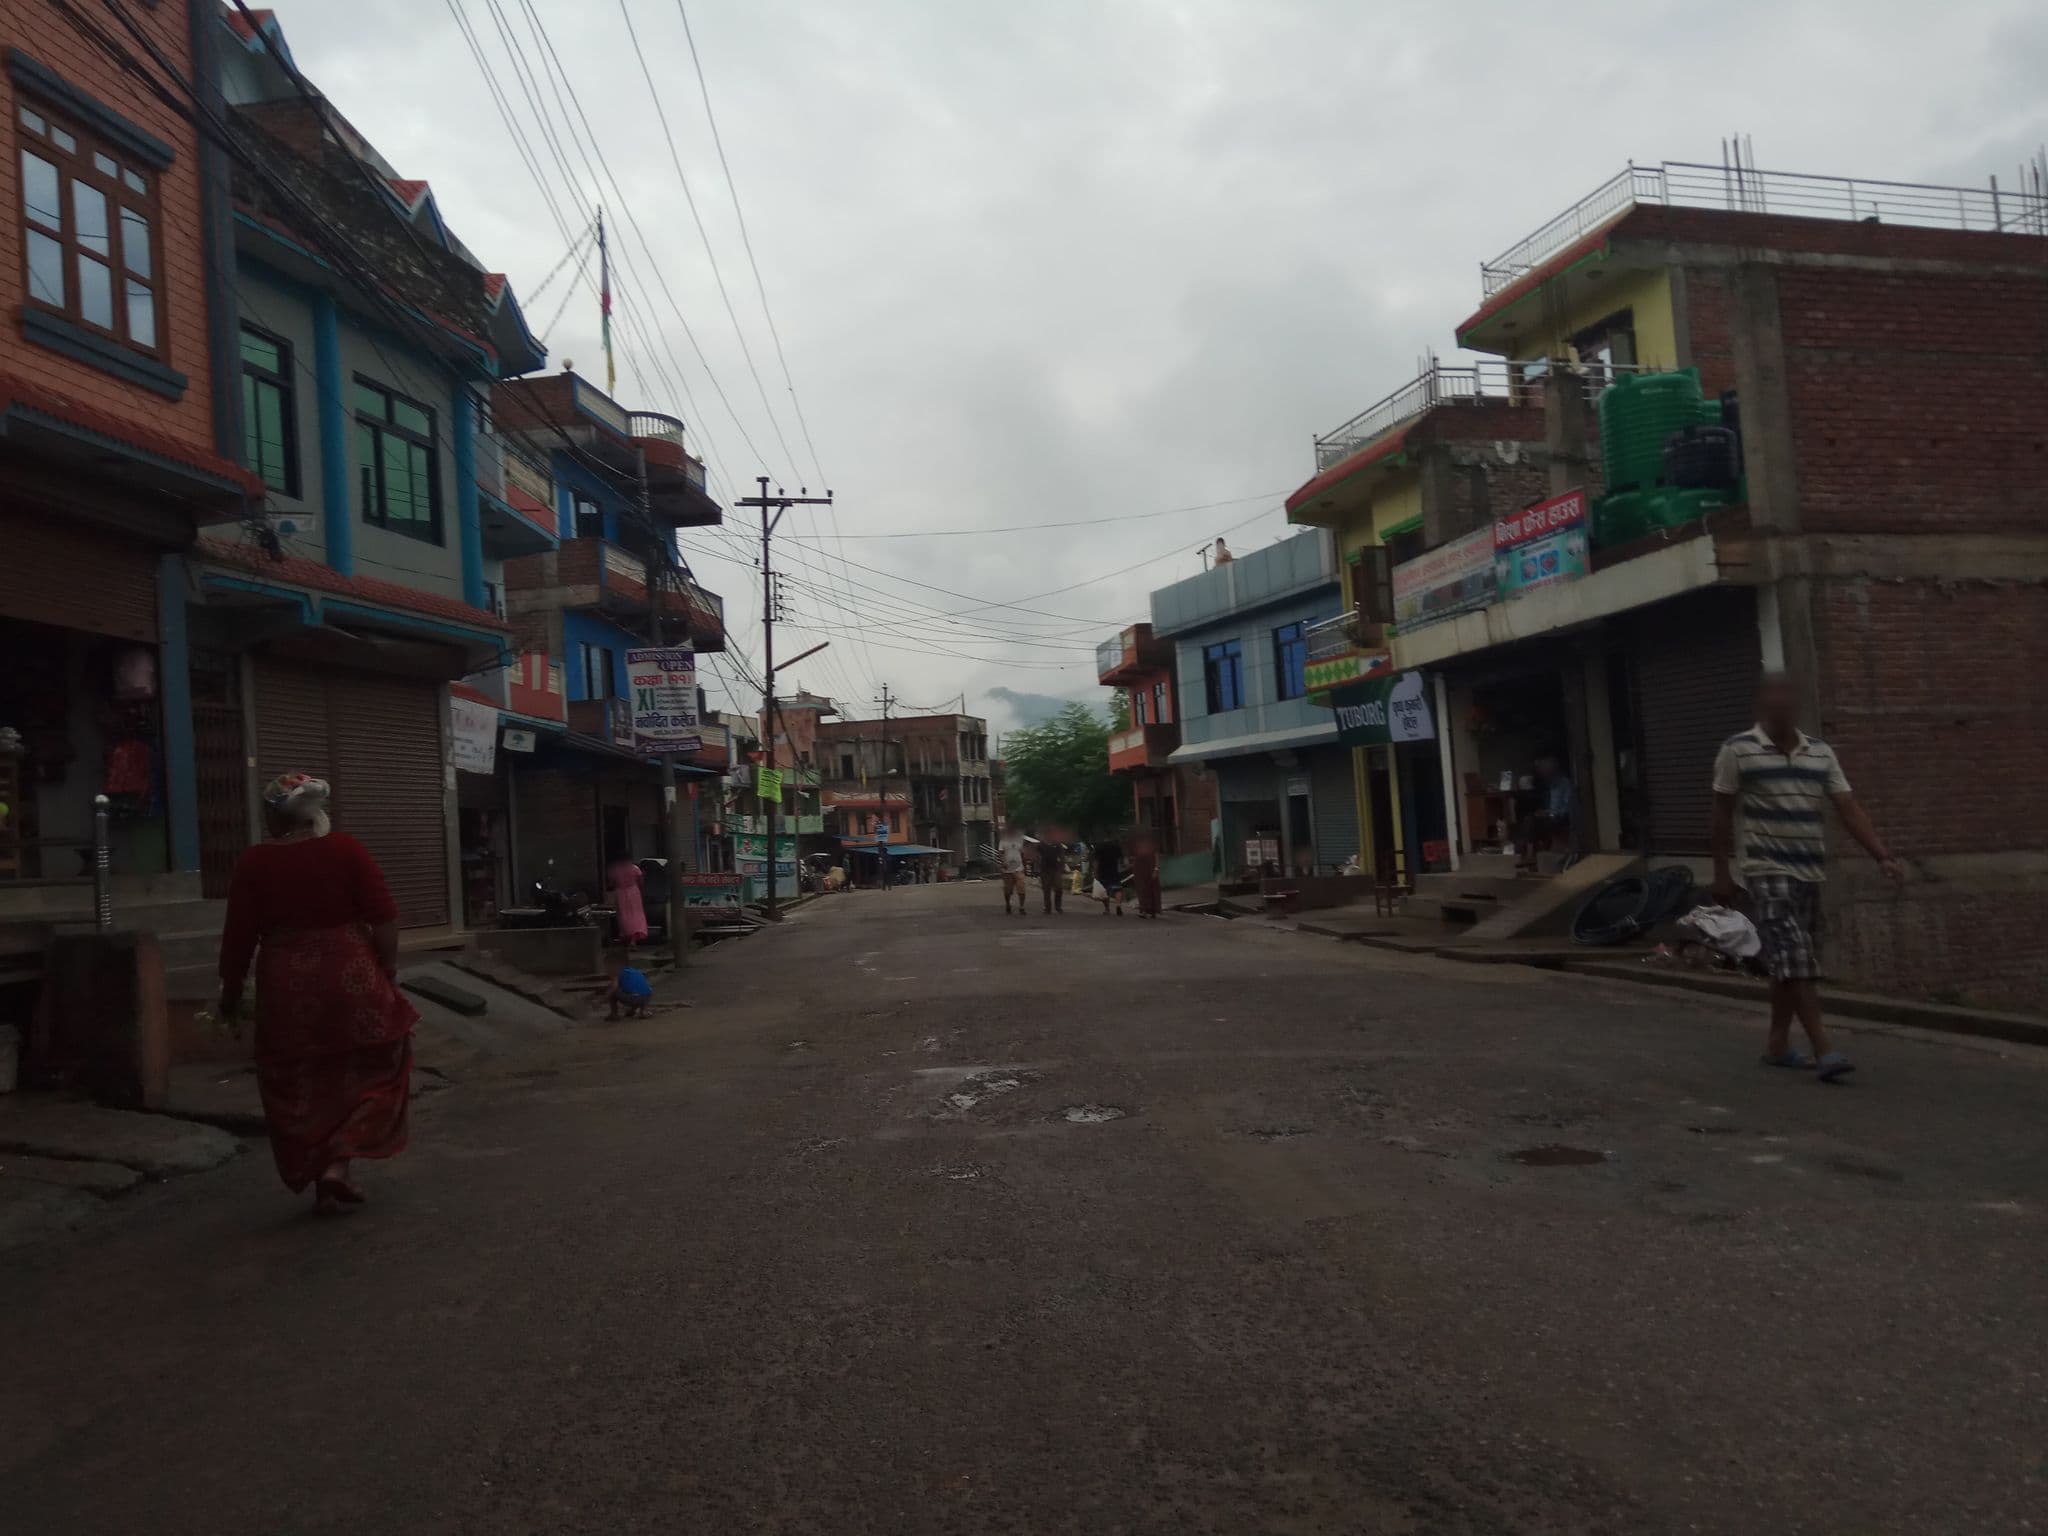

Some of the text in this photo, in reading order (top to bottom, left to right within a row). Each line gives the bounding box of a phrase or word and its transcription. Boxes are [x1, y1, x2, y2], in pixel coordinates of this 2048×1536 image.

[631, 652, 682, 662] ADMISSION
[660, 660, 694, 671] OPEN
[633, 674, 664, 686] कक्षा
[636, 688, 655, 711] XI
[1337, 700, 1386, 731] TUBORG
